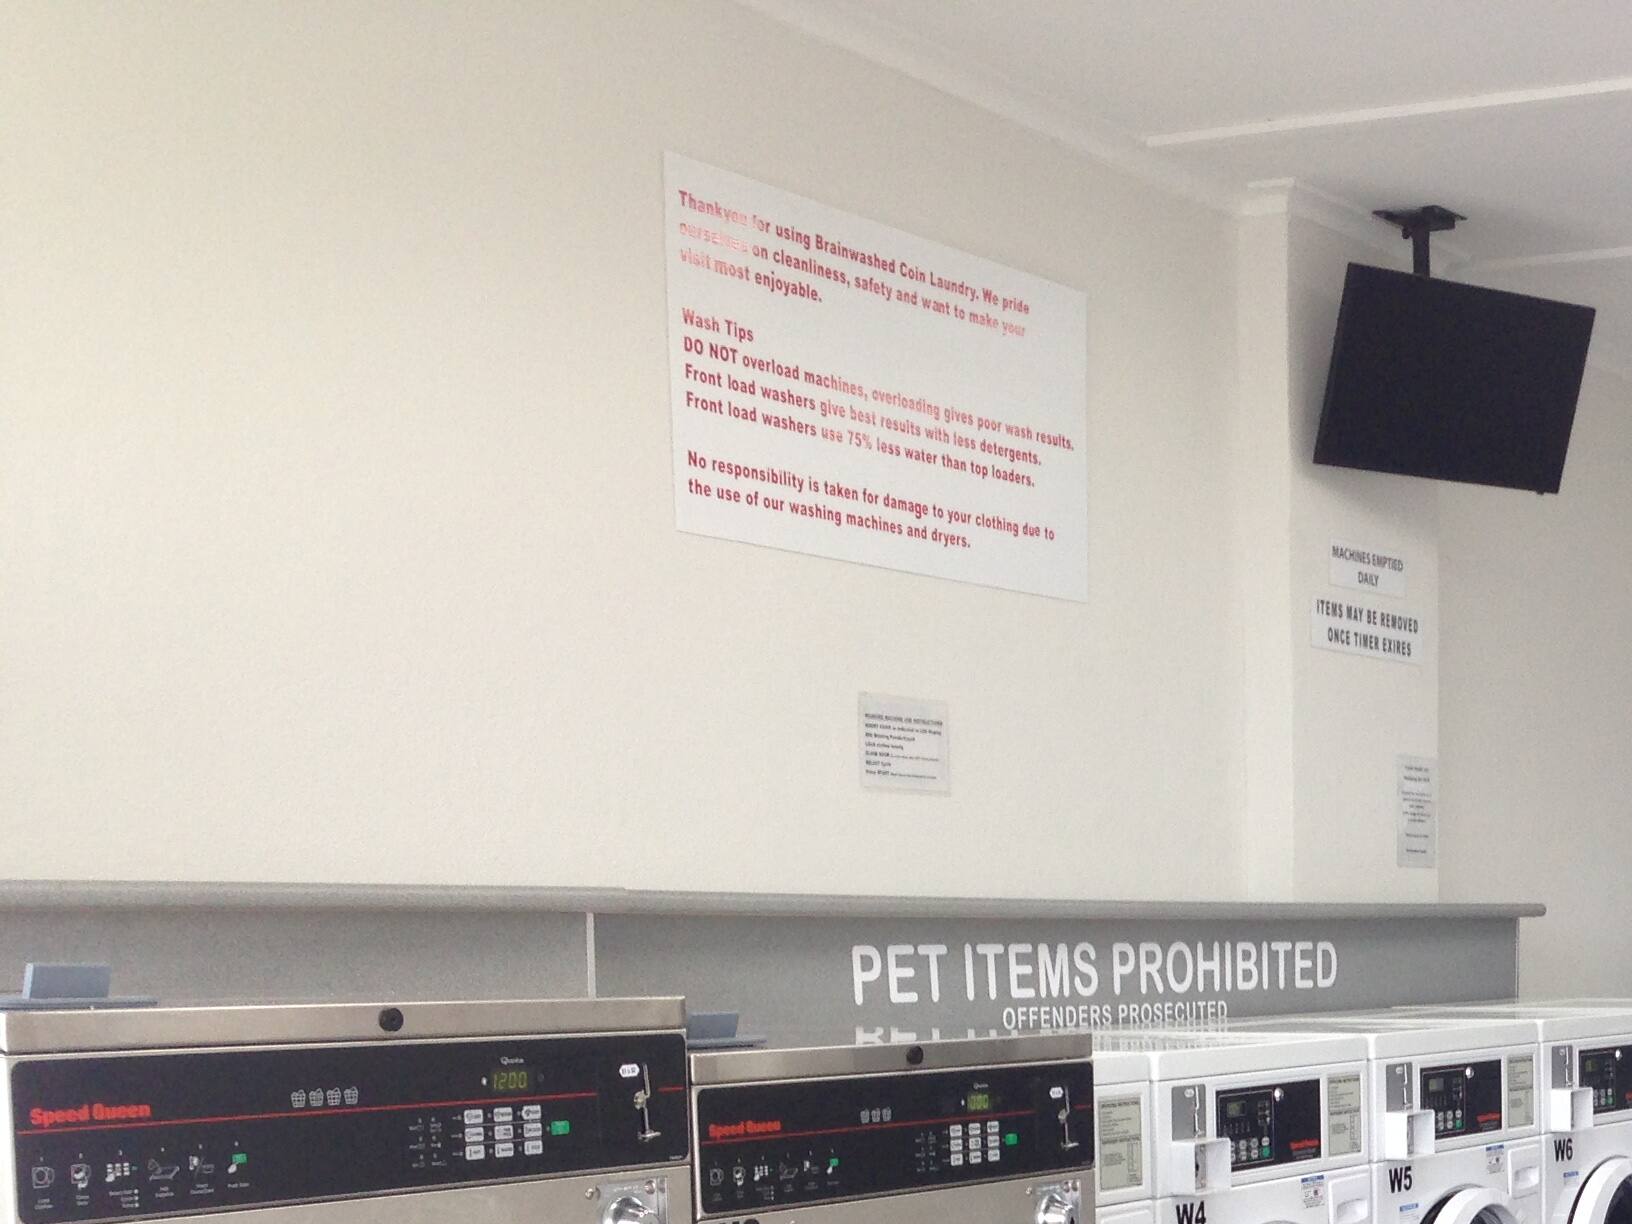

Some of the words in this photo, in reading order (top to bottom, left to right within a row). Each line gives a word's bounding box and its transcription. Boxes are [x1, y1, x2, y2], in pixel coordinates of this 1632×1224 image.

[714, 259, 750, 281] most
[754, 270, 822, 303] enjoyable.
[751, 245, 768, 260] on
[772, 248, 850, 288] cleanliness,
[854, 276, 892, 301] safety
[895, 289, 918, 306] and
[921, 297, 950, 315] want
[953, 304, 965, 320] to
[968, 311, 999, 328] make
[752, 214, 771, 233] for
[775, 224, 811, 250] using
[814, 233, 896, 274] Brainwashed
[899, 261, 926, 283] Coin
[929, 271, 979, 302] Laundry.
[981, 287, 999, 306] We
[1001, 297, 1029, 315] pride
[681, 307, 720, 333] Wash
[724, 318, 754, 343] Tips
[683, 335, 704, 356] DO
[708, 342, 738, 364] NOT
[742, 354, 800, 381] overload
[803, 370, 868, 401] machines,
[871, 389, 940, 421] overloading
[943, 406, 973, 426] gives
[977, 416, 1002, 432] poor
[1004, 423, 1032, 440] wash
[1035, 431, 1074, 451] results.
[684, 362, 722, 388] Front
[727, 373, 756, 396] load
[759, 385, 816, 410] washers
[819, 399, 846, 418] give
[849, 404, 876, 426] best
[880, 416, 921, 437] results
[924, 427, 949, 444] with
[953, 431, 976, 450] less
[979, 438, 1041, 466] detergents.
[685, 390, 723, 415] Front
[727, 400, 757, 423] load
[761, 412, 817, 437] washers
[820, 427, 843, 443] use
[847, 429, 872, 450] 75%
[876, 437, 901, 457] less
[904, 447, 937, 465] water
[941, 453, 967, 472] than
[969, 460, 988, 479] top
[991, 464, 1034, 488] loaders.
[687, 449, 707, 469] No
[711, 458, 804, 493] responsibility
[808, 475, 819, 493] is
[823, 480, 858, 501] taken
[861, 487, 879, 505] for
[882, 492, 928, 519] damage
[931, 503, 944, 519] to
[946, 509, 971, 524] your
[975, 512, 1019, 538] clothing
[1021, 521, 1040, 537] due
[1043, 526, 1055, 541] to
[687, 477, 712, 497] the
[716, 487, 741, 503] use
[745, 490, 759, 507] of
[762, 496, 785, 512] our
[788, 501, 842, 527] washing
[845, 512, 903, 535] machines
[906, 525, 927, 540] and
[930, 527, 970, 548] dryers.
[1332, 545, 1371, 565] MACHINES
[1372, 554, 1403, 572] EMPTIED
[1358, 571, 1379, 587] DAILY
[1316, 600, 1343, 618] ITEMS
[1346, 605, 1363, 623] MAY
[1367, 609, 1377, 625] BE
[1380, 612, 1418, 634] REMOVED
[1327, 627, 1350, 645] ONCE
[1354, 632, 1379, 650] TIMER
[1382, 637, 1412, 657] EXIRES
[852, 943, 948, 1006] PET
[964, 942, 1098, 1001] ITEMS
[1112, 941, 1338, 996] PROHIBITED
[1002, 1003, 1112, 1030] OFFENDERS
[1118, 1000, 1228, 1025] PROSECUTED
[1554, 1138, 1573, 1162] W6
[1389, 1165, 1412, 1194] W5
